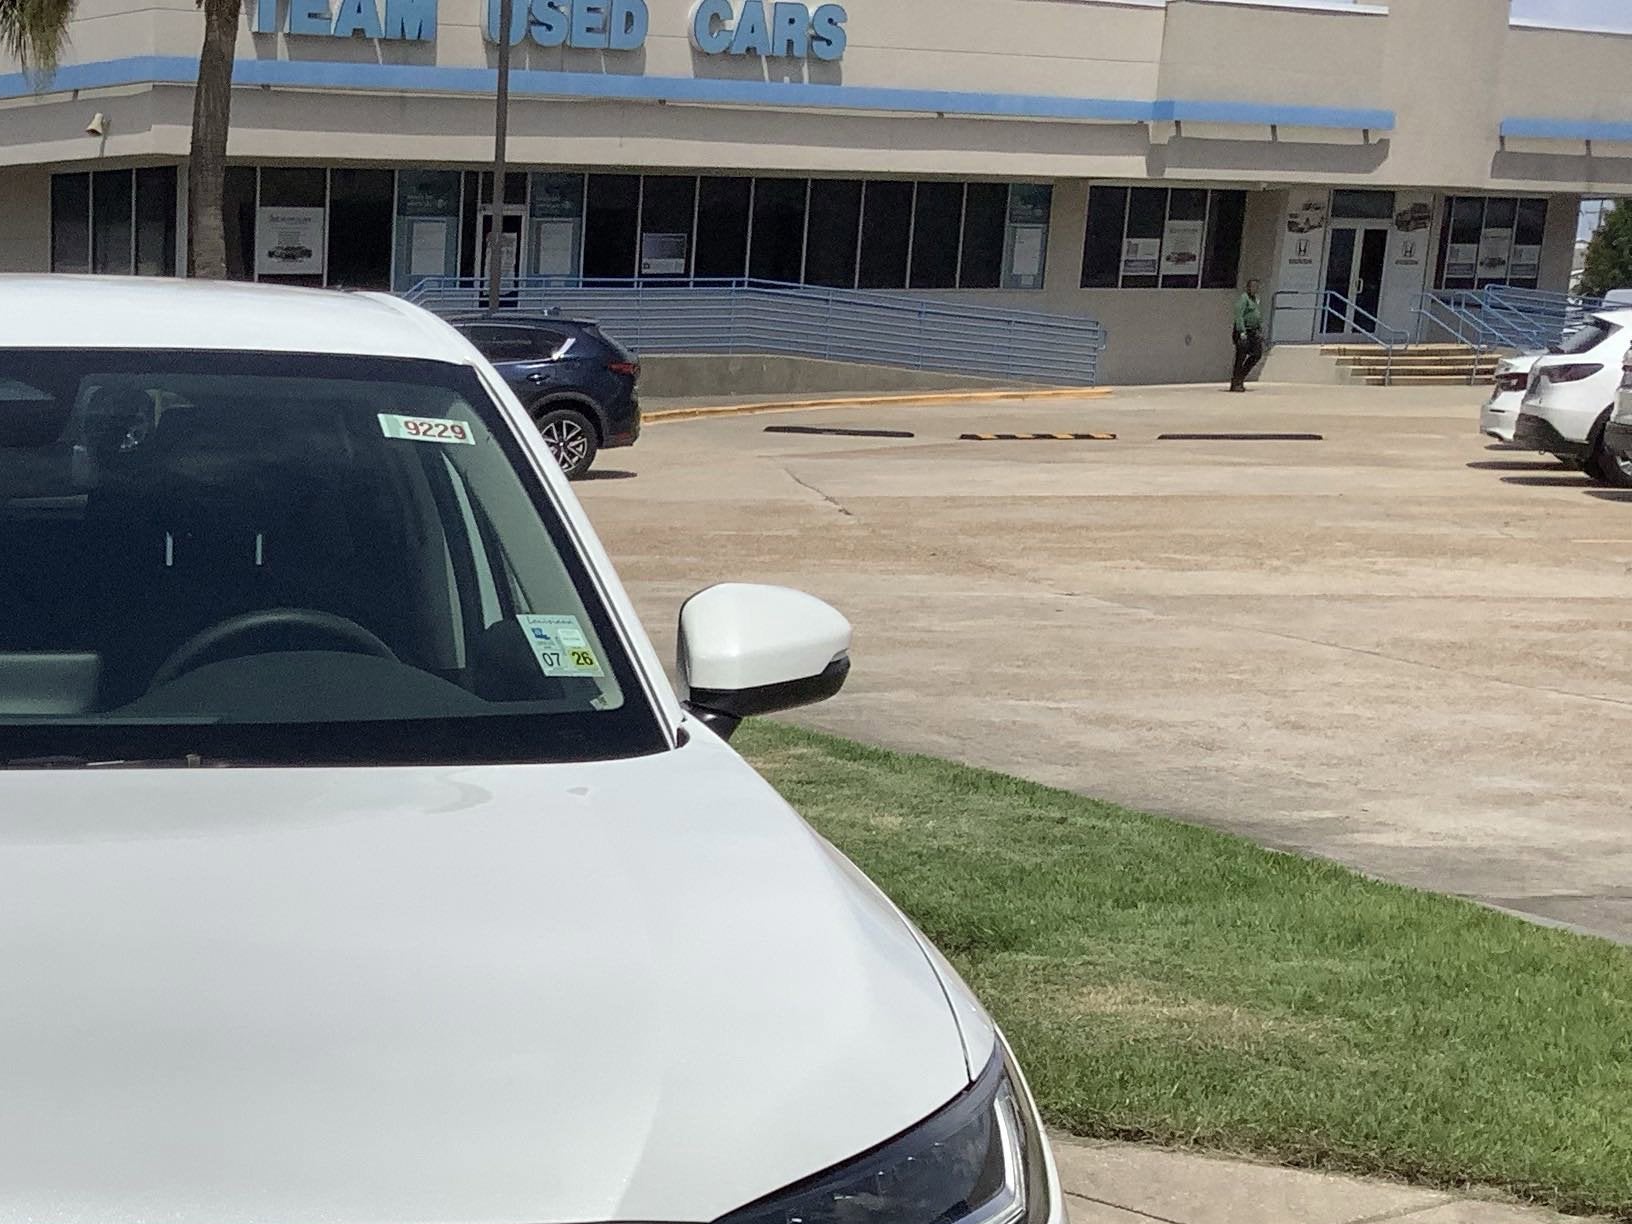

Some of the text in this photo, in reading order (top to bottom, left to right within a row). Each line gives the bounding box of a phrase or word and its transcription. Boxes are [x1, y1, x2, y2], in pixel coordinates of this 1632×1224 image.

[487, 0, 649, 49] USED
[693, 0, 847, 60] CARS
[404, 420, 467, 440] 9229
[542, 651, 594, 667] 07 26
